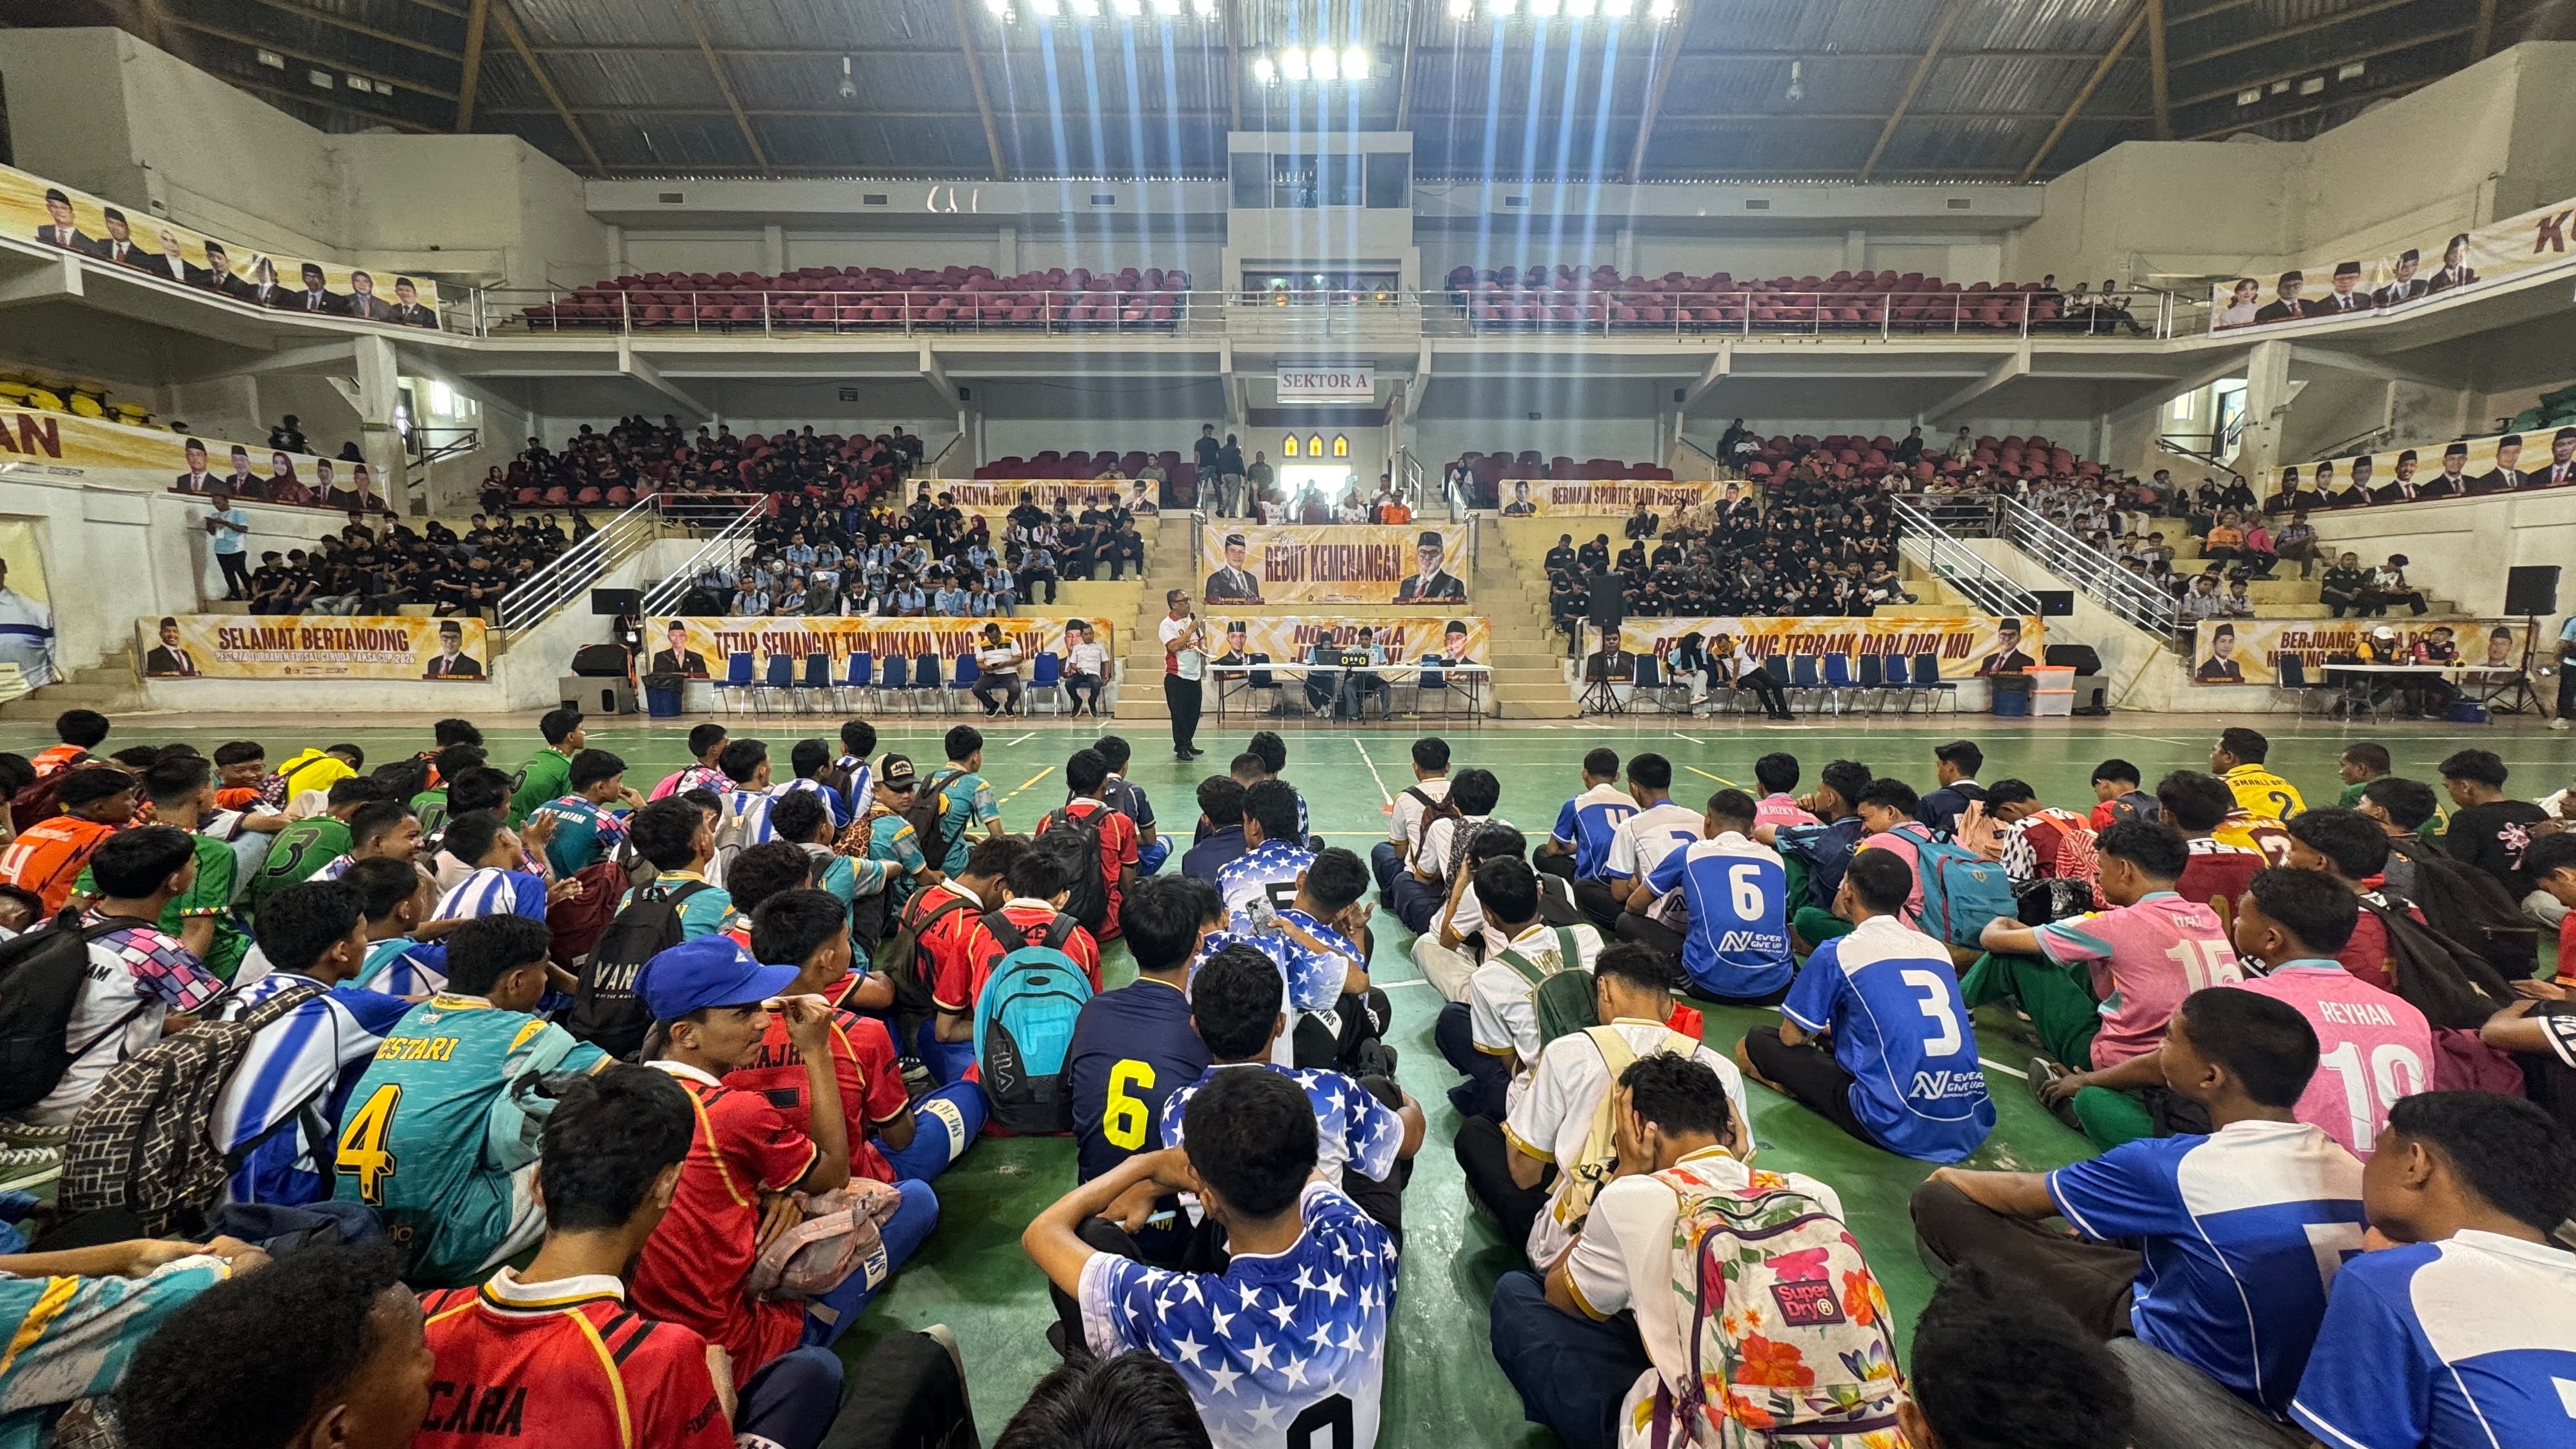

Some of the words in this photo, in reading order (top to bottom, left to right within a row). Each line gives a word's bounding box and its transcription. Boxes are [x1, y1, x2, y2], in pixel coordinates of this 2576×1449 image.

[1283, 374, 1351, 388] SEKTOR
[1356, 374, 1368, 388] A
[950, 485, 990, 505] SAATNYA
[1552, 486, 1592, 505] BERMAIN
[1634, 487, 1656, 505] RAIH
[1265, 545, 1307, 583] REBUT
[1310, 544, 1401, 583] KEMENANGAN
[218, 627, 296, 650] SELAMAT
[301, 627, 410, 651] BERTANDING
[714, 631, 758, 660] TETAP
[935, 631, 975, 660] YANG
[1293, 625, 1324, 645] NO
[1331, 625, 1405, 645] DRMA
[1784, 633, 1858, 660] TERBAIK
[1943, 633, 1974, 659] MU
[2280, 631, 2356, 649] BERJUANG
[394, 653, 415, 664] 2026
[1728, 864, 1765, 922] 6
[1755, 933, 1782, 942] EVER
[593, 960, 640, 990] VAN
[1900, 970, 1961, 1057] 3
[2317, 1000, 2396, 1026] REYHAN
[374, 1036, 460, 1061] ESTARI
[992, 1038, 1015, 1092] FILA
[1953, 1071, 1984, 1082] EVER
[1103, 1059, 1156, 1151] 6
[333, 1083, 403, 1207] 4
[1778, 1285, 1829, 1302] Super
